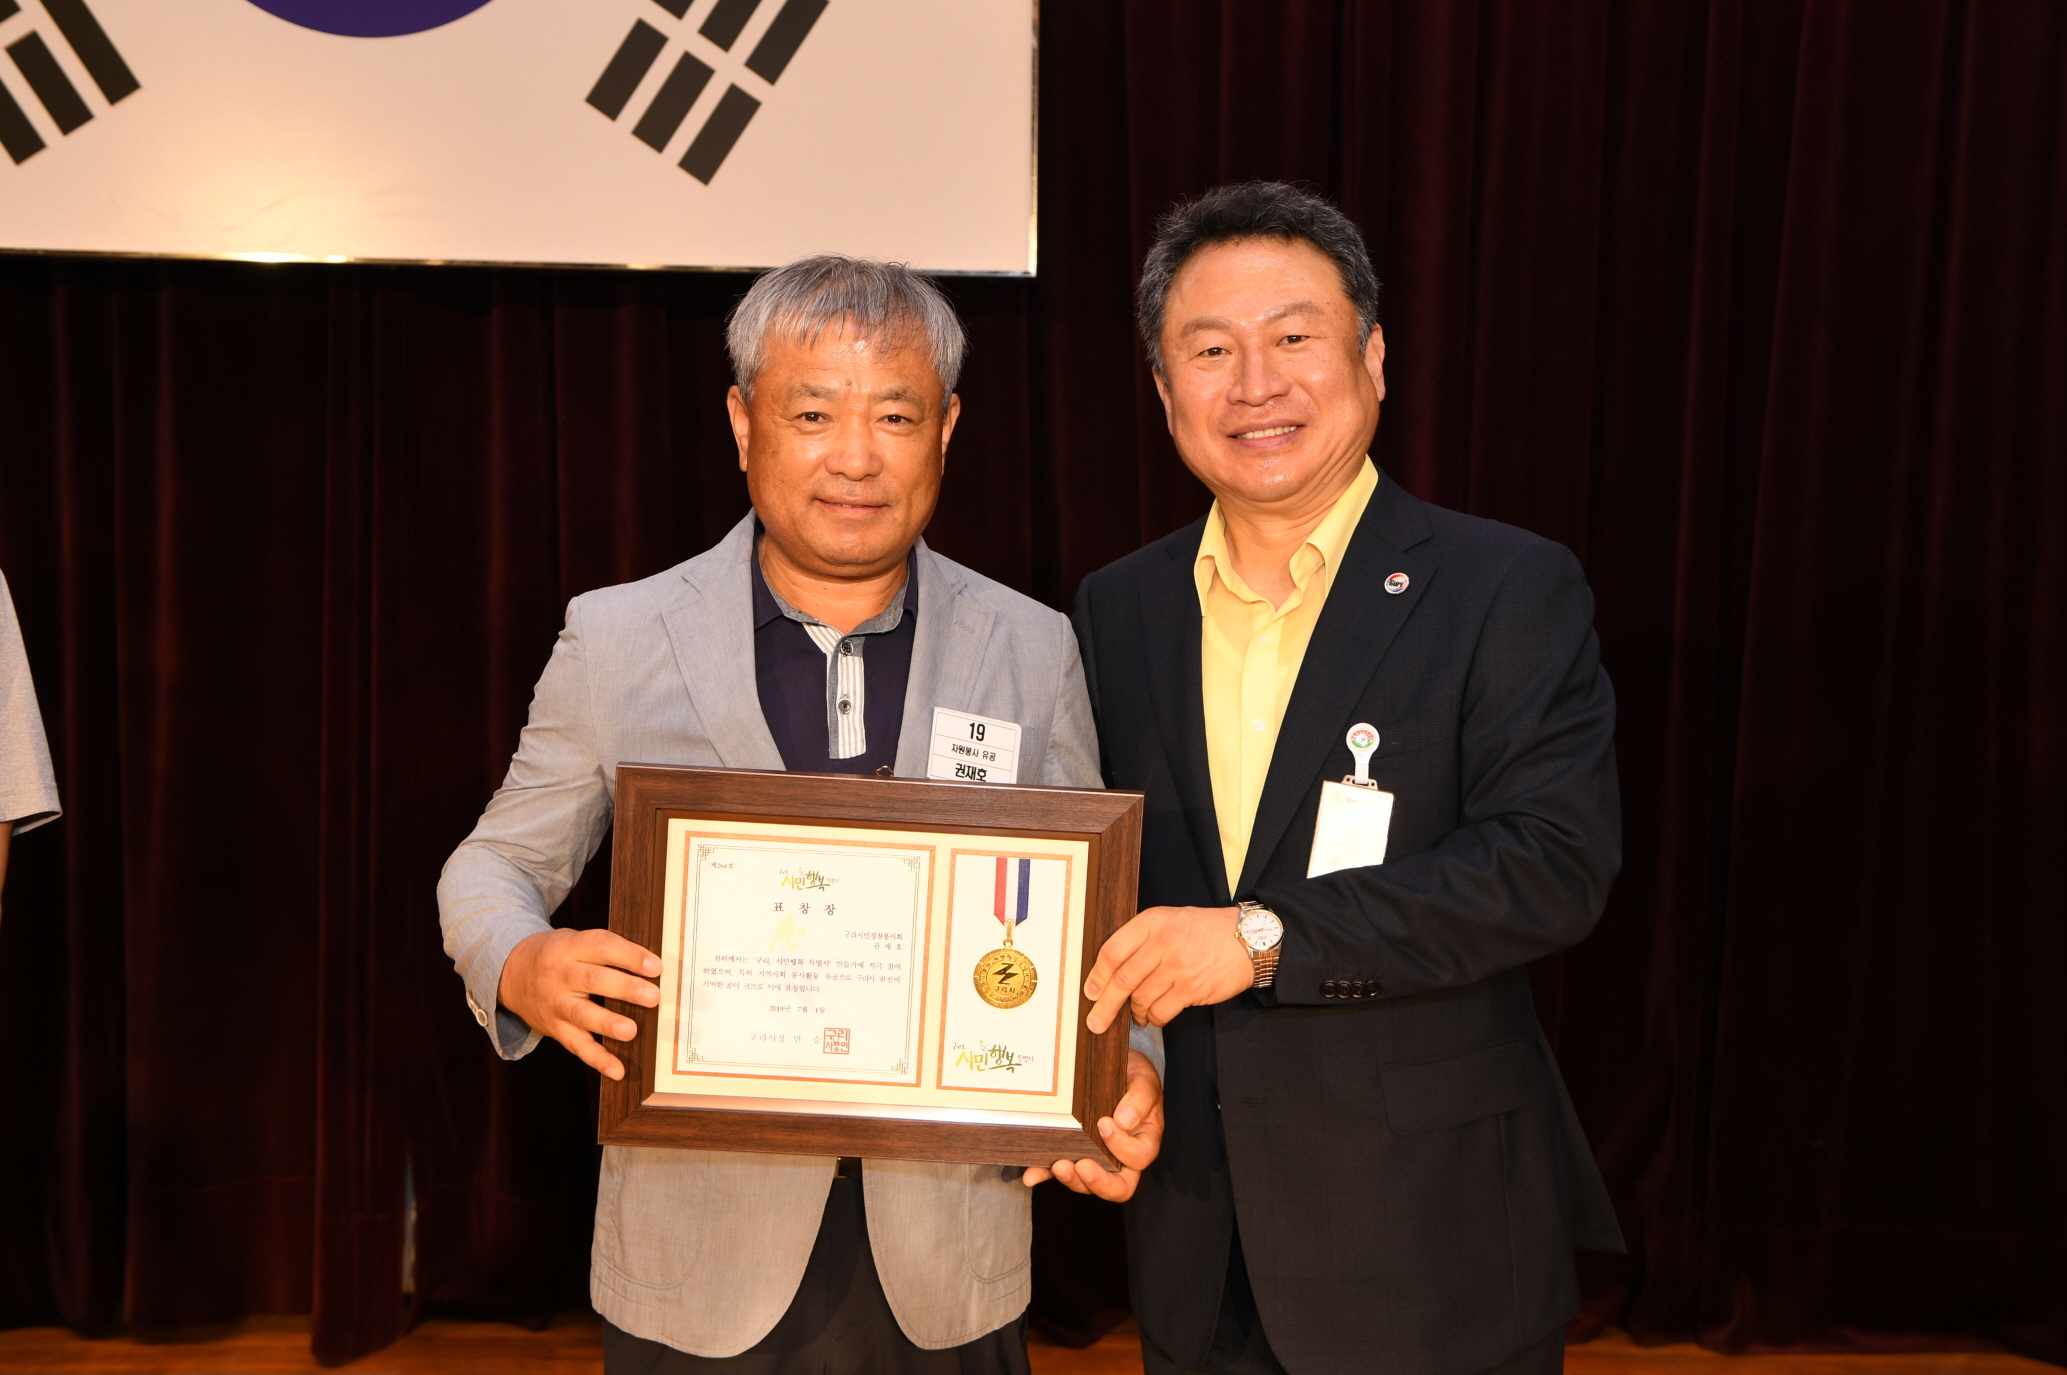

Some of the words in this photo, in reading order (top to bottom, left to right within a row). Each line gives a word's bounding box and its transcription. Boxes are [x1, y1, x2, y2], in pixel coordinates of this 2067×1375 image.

[969, 722, 986, 742] 19
[951, 743, 979, 758] 자원봉사
[982, 750, 996, 762] 유공
[955, 762, 987, 782] 권재호
[781, 870, 830, 891] 시민행복
[772, 902, 785, 912] 표
[799, 902, 811, 914] 창
[824, 904, 836, 916] 장
[844, 930, 903, 941] 구리시민경찰봉사회
[714, 954, 749, 963] 귀하께서는
[776, 958, 804, 966] 시민행복
[836, 960, 864, 969] 만들기에
[869, 962, 883, 970] 적극
[703, 967, 733, 976] 하였으며,
[738, 969, 752, 977] 특히
[758, 970, 786, 978] 지역사회
[791, 972, 820, 980] 봉사활동
[825, 973, 852, 981] 유공으로
[855, 974, 874, 982] 구리시
[879, 975, 901, 984] 발전에
[702, 980, 723, 988] 기여한
[767, 983, 781, 991] 이에
[785, 984, 821, 993] 표창합니다.
[798, 1006, 808, 1014] 7월
[825, 1029, 848, 1041] 구리
[825, 1041, 848, 1053] 시장인
[955, 1044, 1022, 1074] 시민행복
